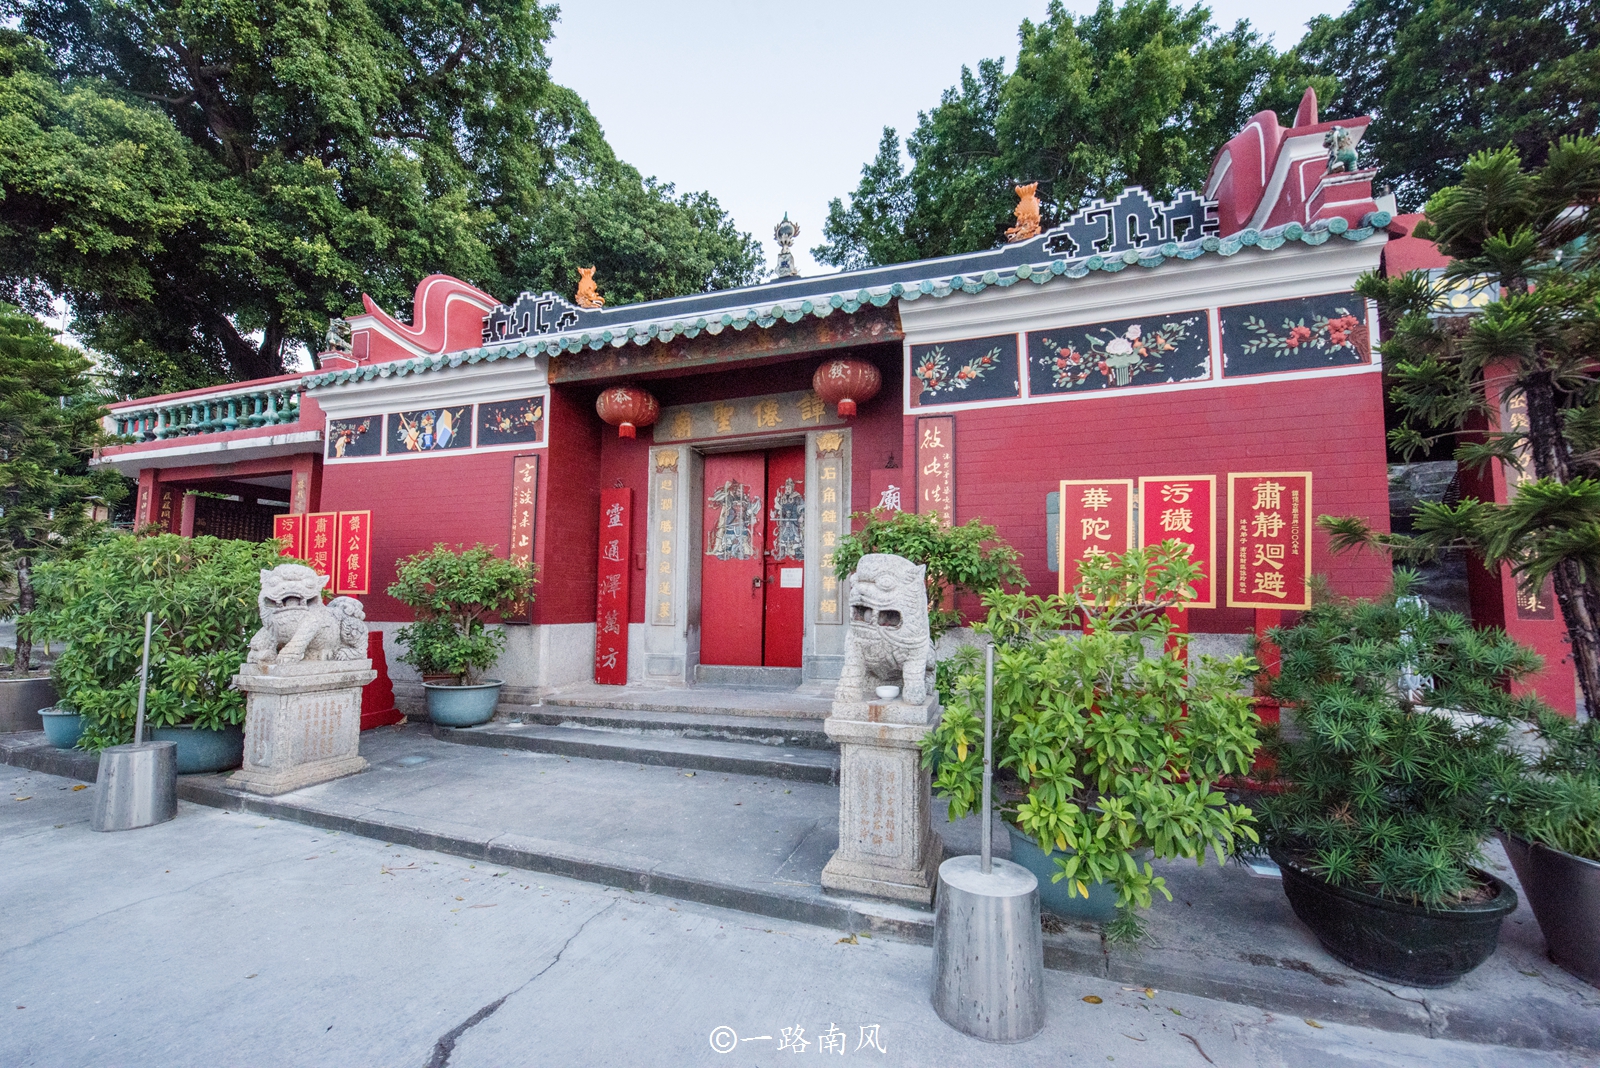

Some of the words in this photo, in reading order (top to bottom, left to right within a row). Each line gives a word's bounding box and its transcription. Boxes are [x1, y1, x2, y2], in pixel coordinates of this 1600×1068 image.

[1078, 487, 1112, 595] 華陀先
[1159, 484, 1195, 600] 污穢勿
